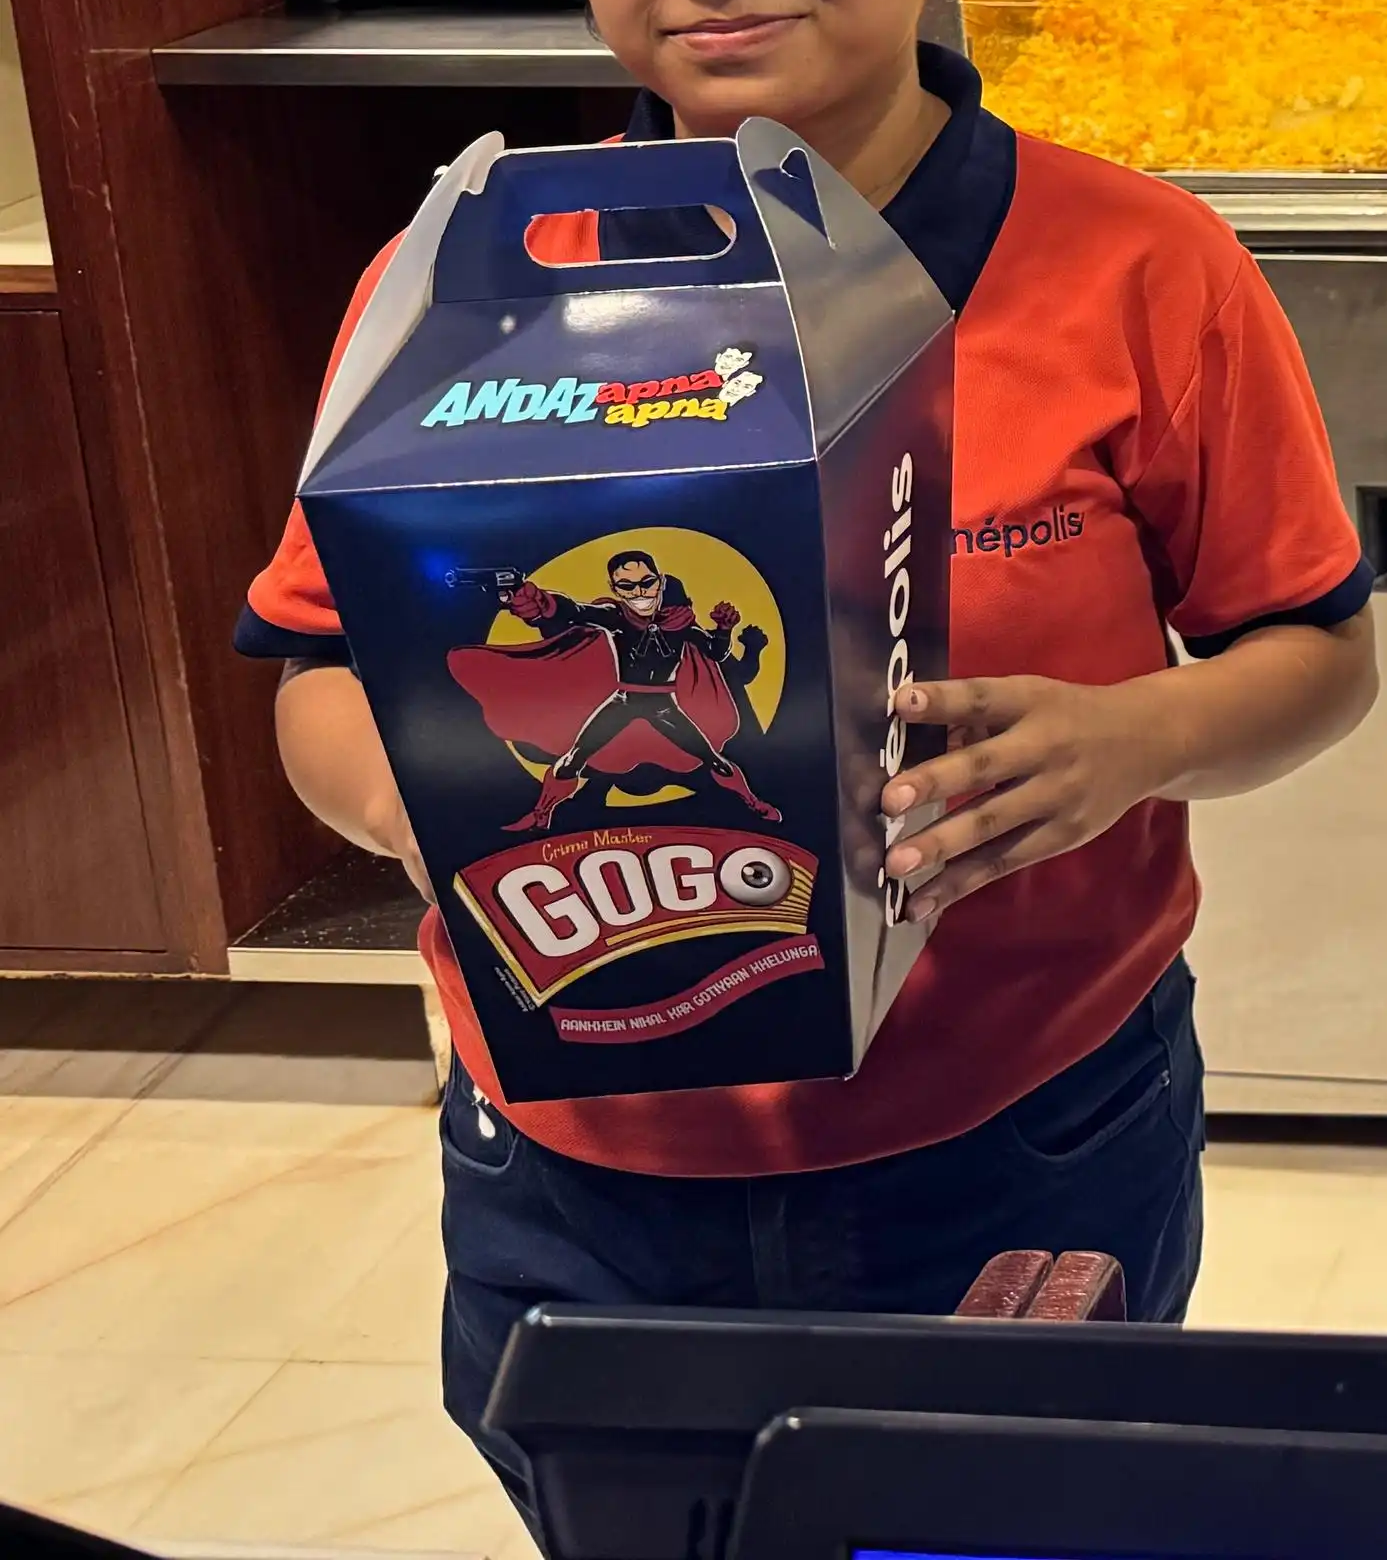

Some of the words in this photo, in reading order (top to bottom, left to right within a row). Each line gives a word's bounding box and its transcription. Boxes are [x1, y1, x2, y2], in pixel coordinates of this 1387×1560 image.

[420, 377, 607, 428] ANDAZ
[594, 369, 725, 404] apna
[604, 397, 728, 428] apna
[542, 840, 589, 863] Crime
[593, 827, 653, 847] Master
[497, 844, 794, 958] GOGO
